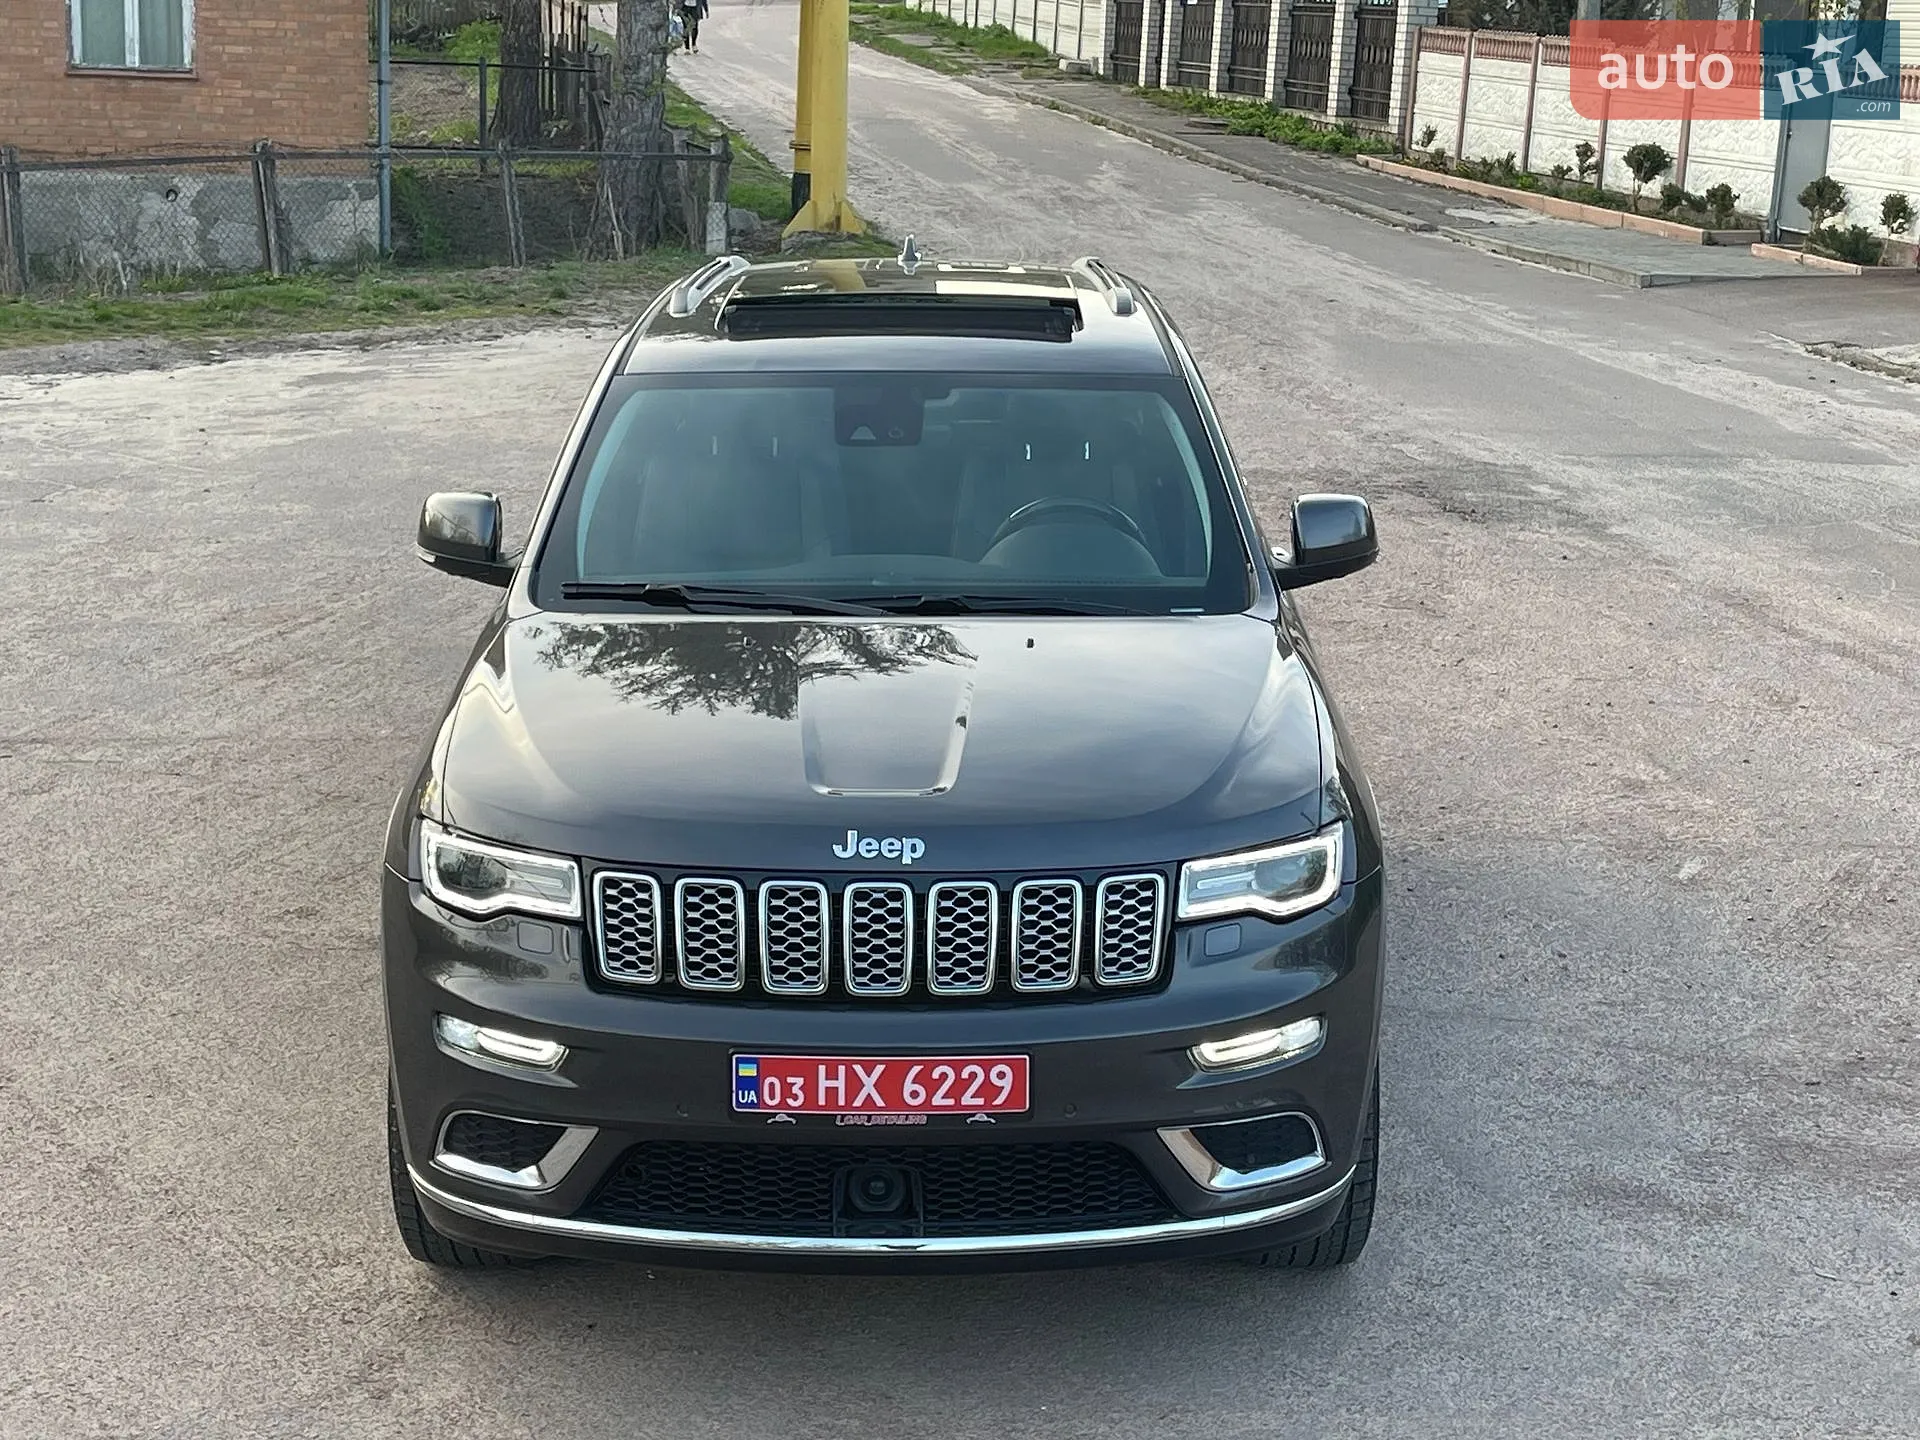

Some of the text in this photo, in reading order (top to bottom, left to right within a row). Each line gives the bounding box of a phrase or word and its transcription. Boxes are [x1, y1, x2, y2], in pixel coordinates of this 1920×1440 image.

[832, 829, 926, 865] Jeep
[738, 1090, 758, 1105] UA
[762, 1064, 1014, 1107] 03 HX 6229
